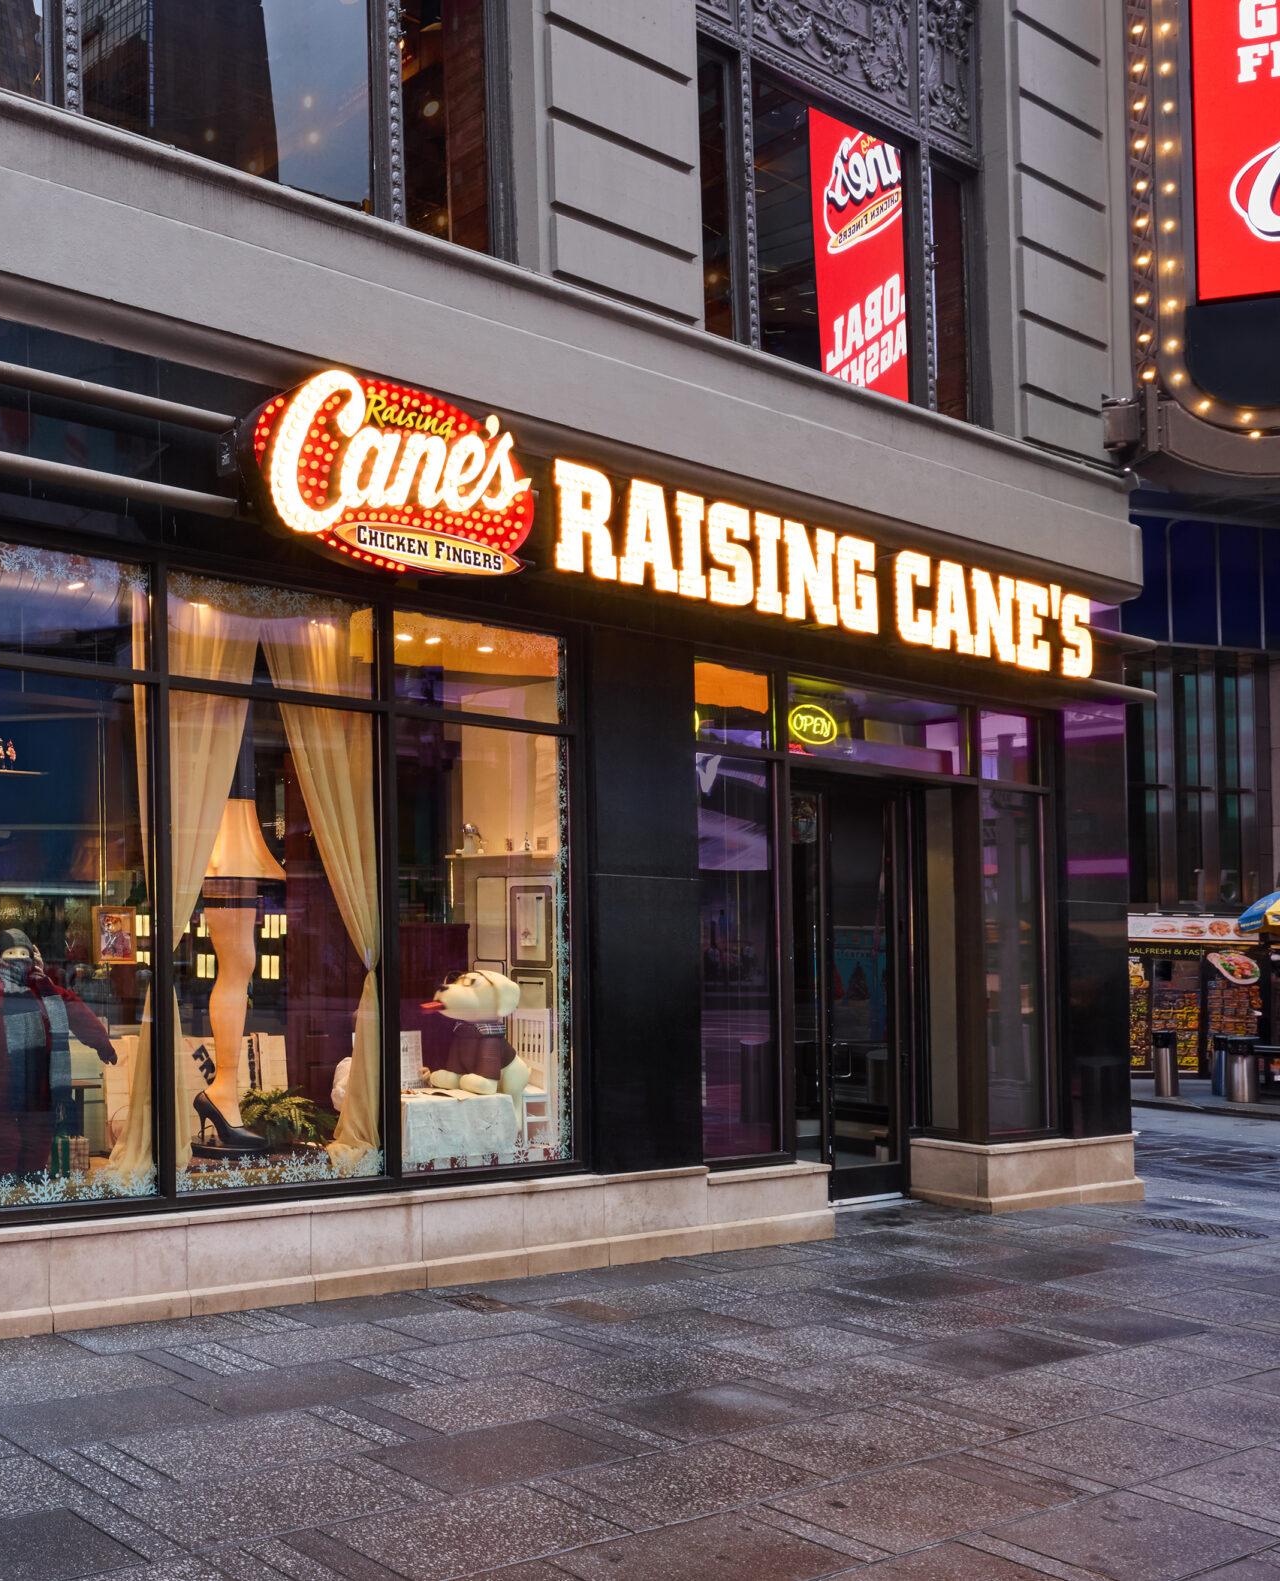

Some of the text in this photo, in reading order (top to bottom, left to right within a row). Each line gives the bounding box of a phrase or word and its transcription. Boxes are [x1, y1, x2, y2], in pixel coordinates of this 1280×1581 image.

[365, 393, 455, 444] Raising
[270, 369, 532, 534] Cane's
[356, 524, 503, 572] CHICKEN FINGERS
[554, 458, 1094, 678] RAISING CANE'S
[793, 713, 831, 738] OPEN
